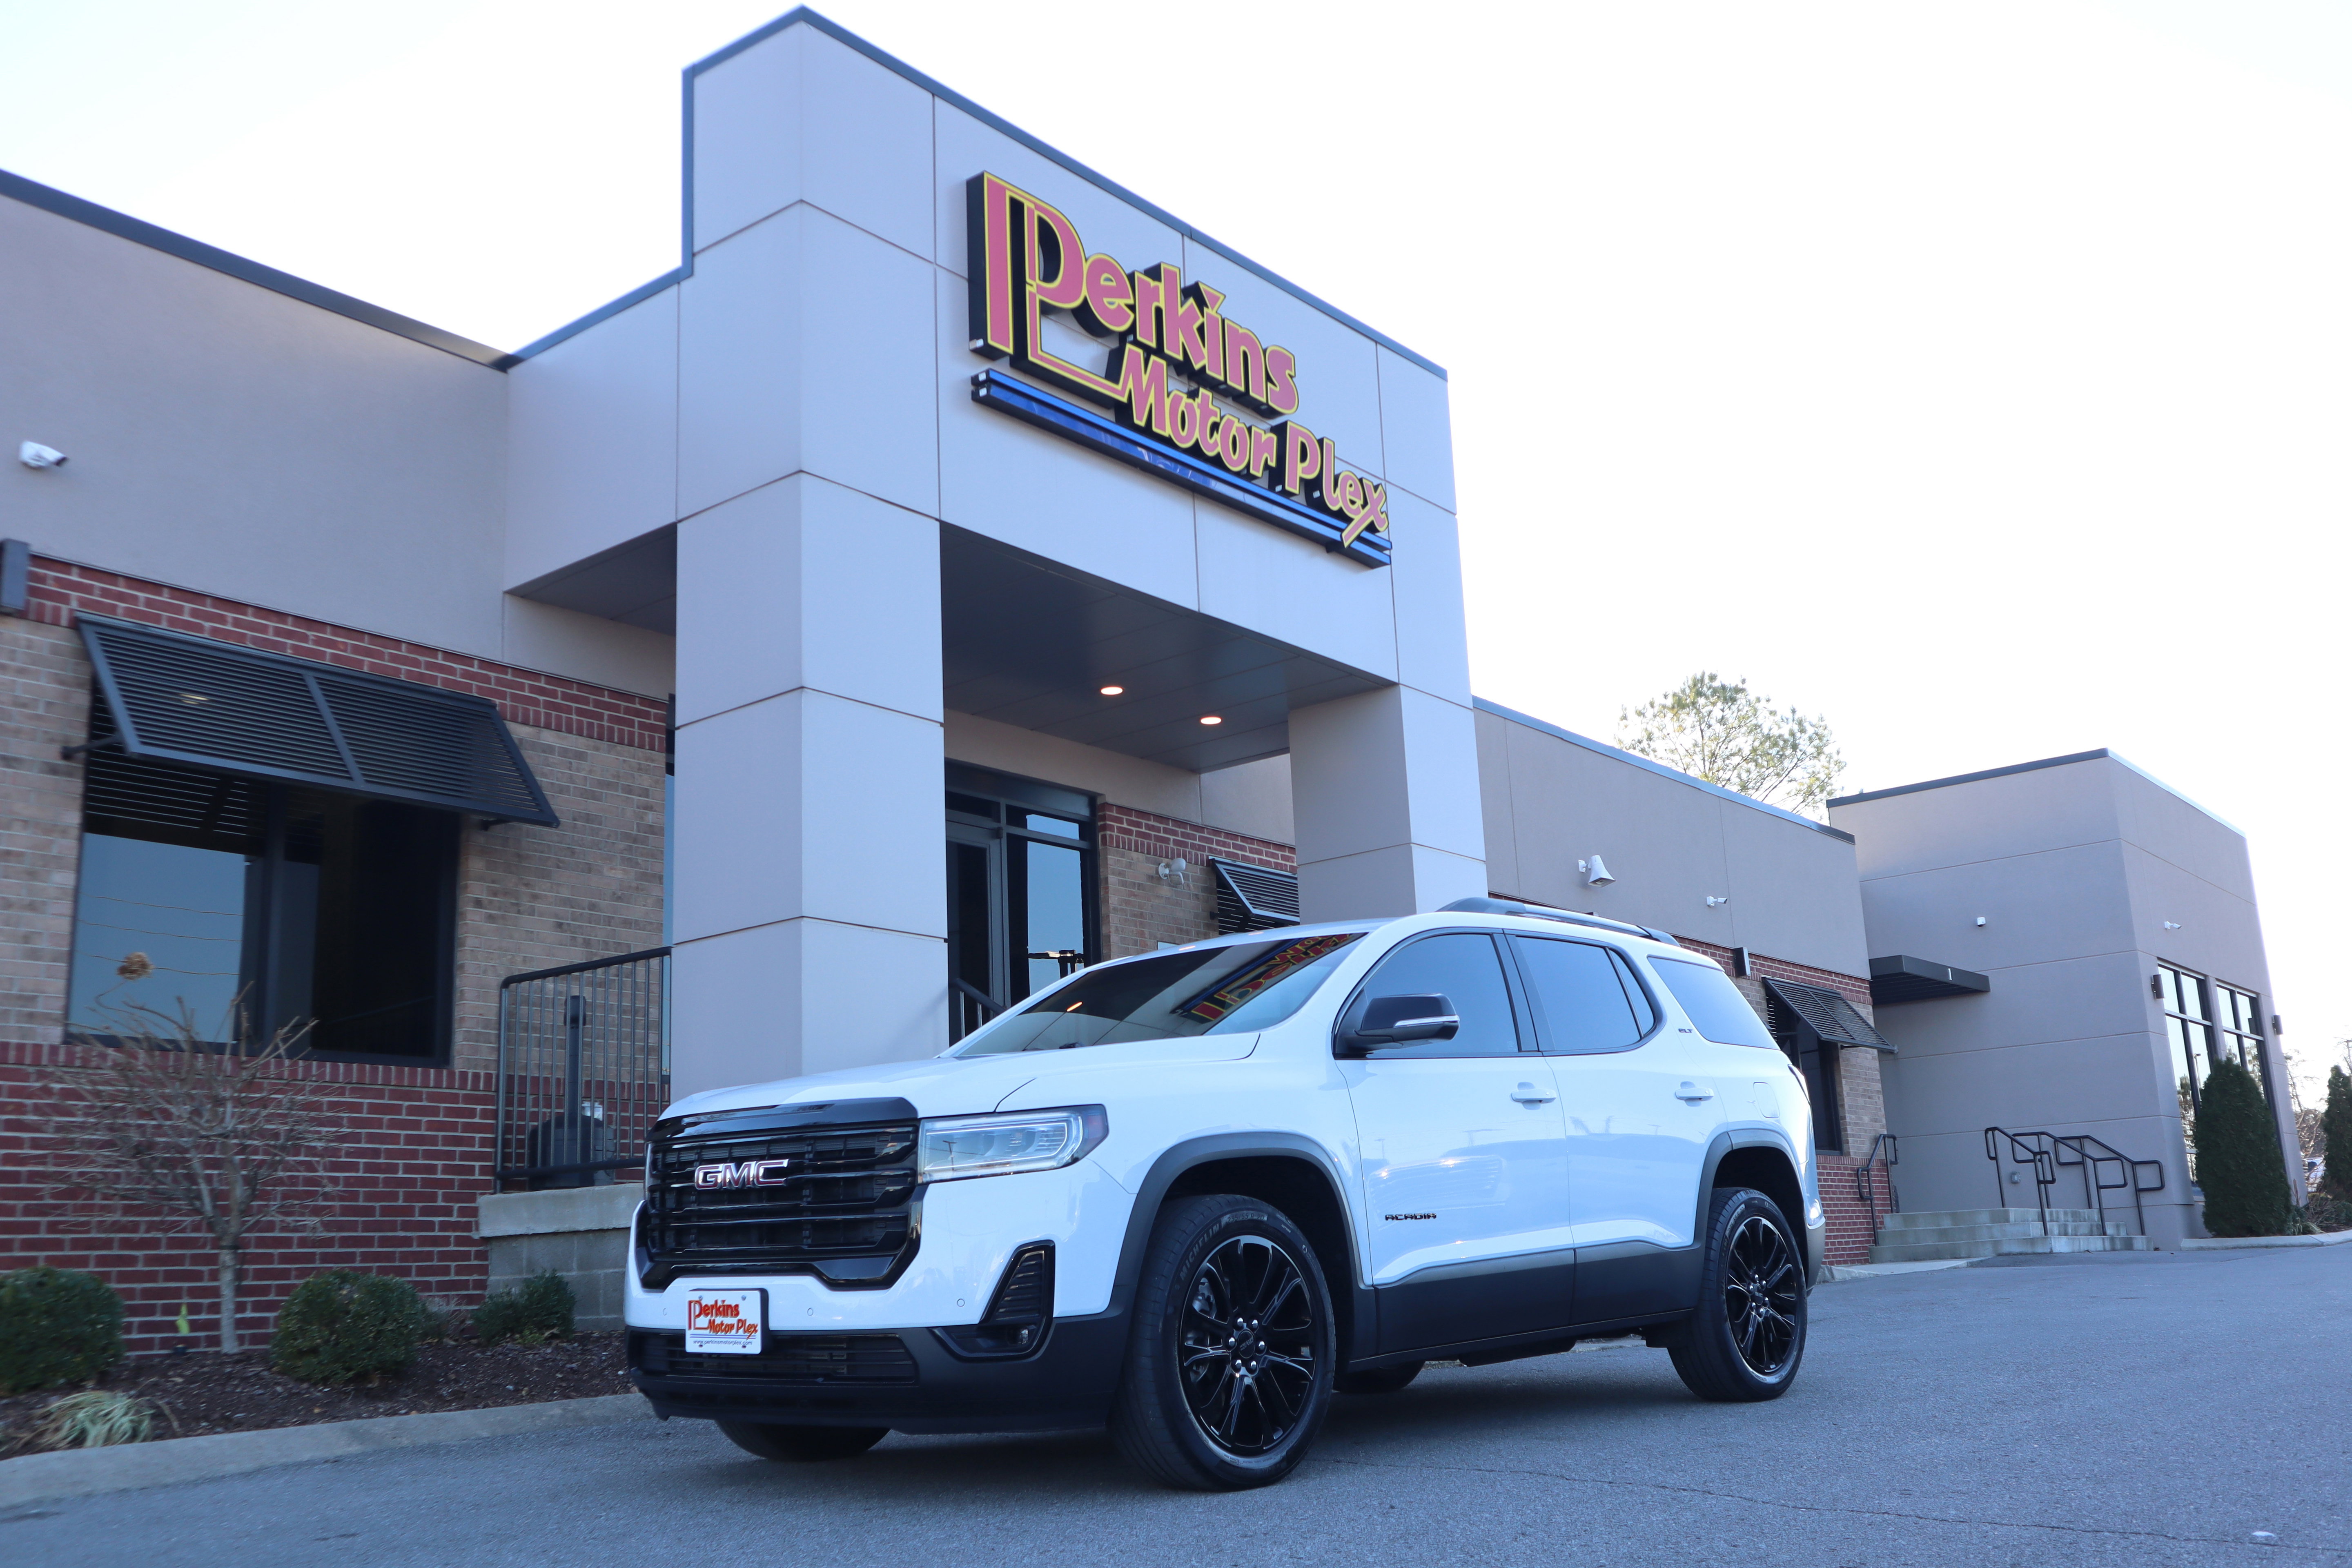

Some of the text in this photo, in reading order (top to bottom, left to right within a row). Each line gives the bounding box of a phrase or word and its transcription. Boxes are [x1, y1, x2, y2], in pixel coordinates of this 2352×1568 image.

[983, 170, 1299, 414] Perkins
[1120, 342, 1388, 548] Motor Plex
[695, 1159, 789, 1190] GMC
[1385, 1213, 1437, 1221] ACADIA
[1179, 1223, 1219, 1281] MICHELIN
[688, 1299, 739, 1330] Perkins
[708, 1319, 758, 1340] Motor Plex
